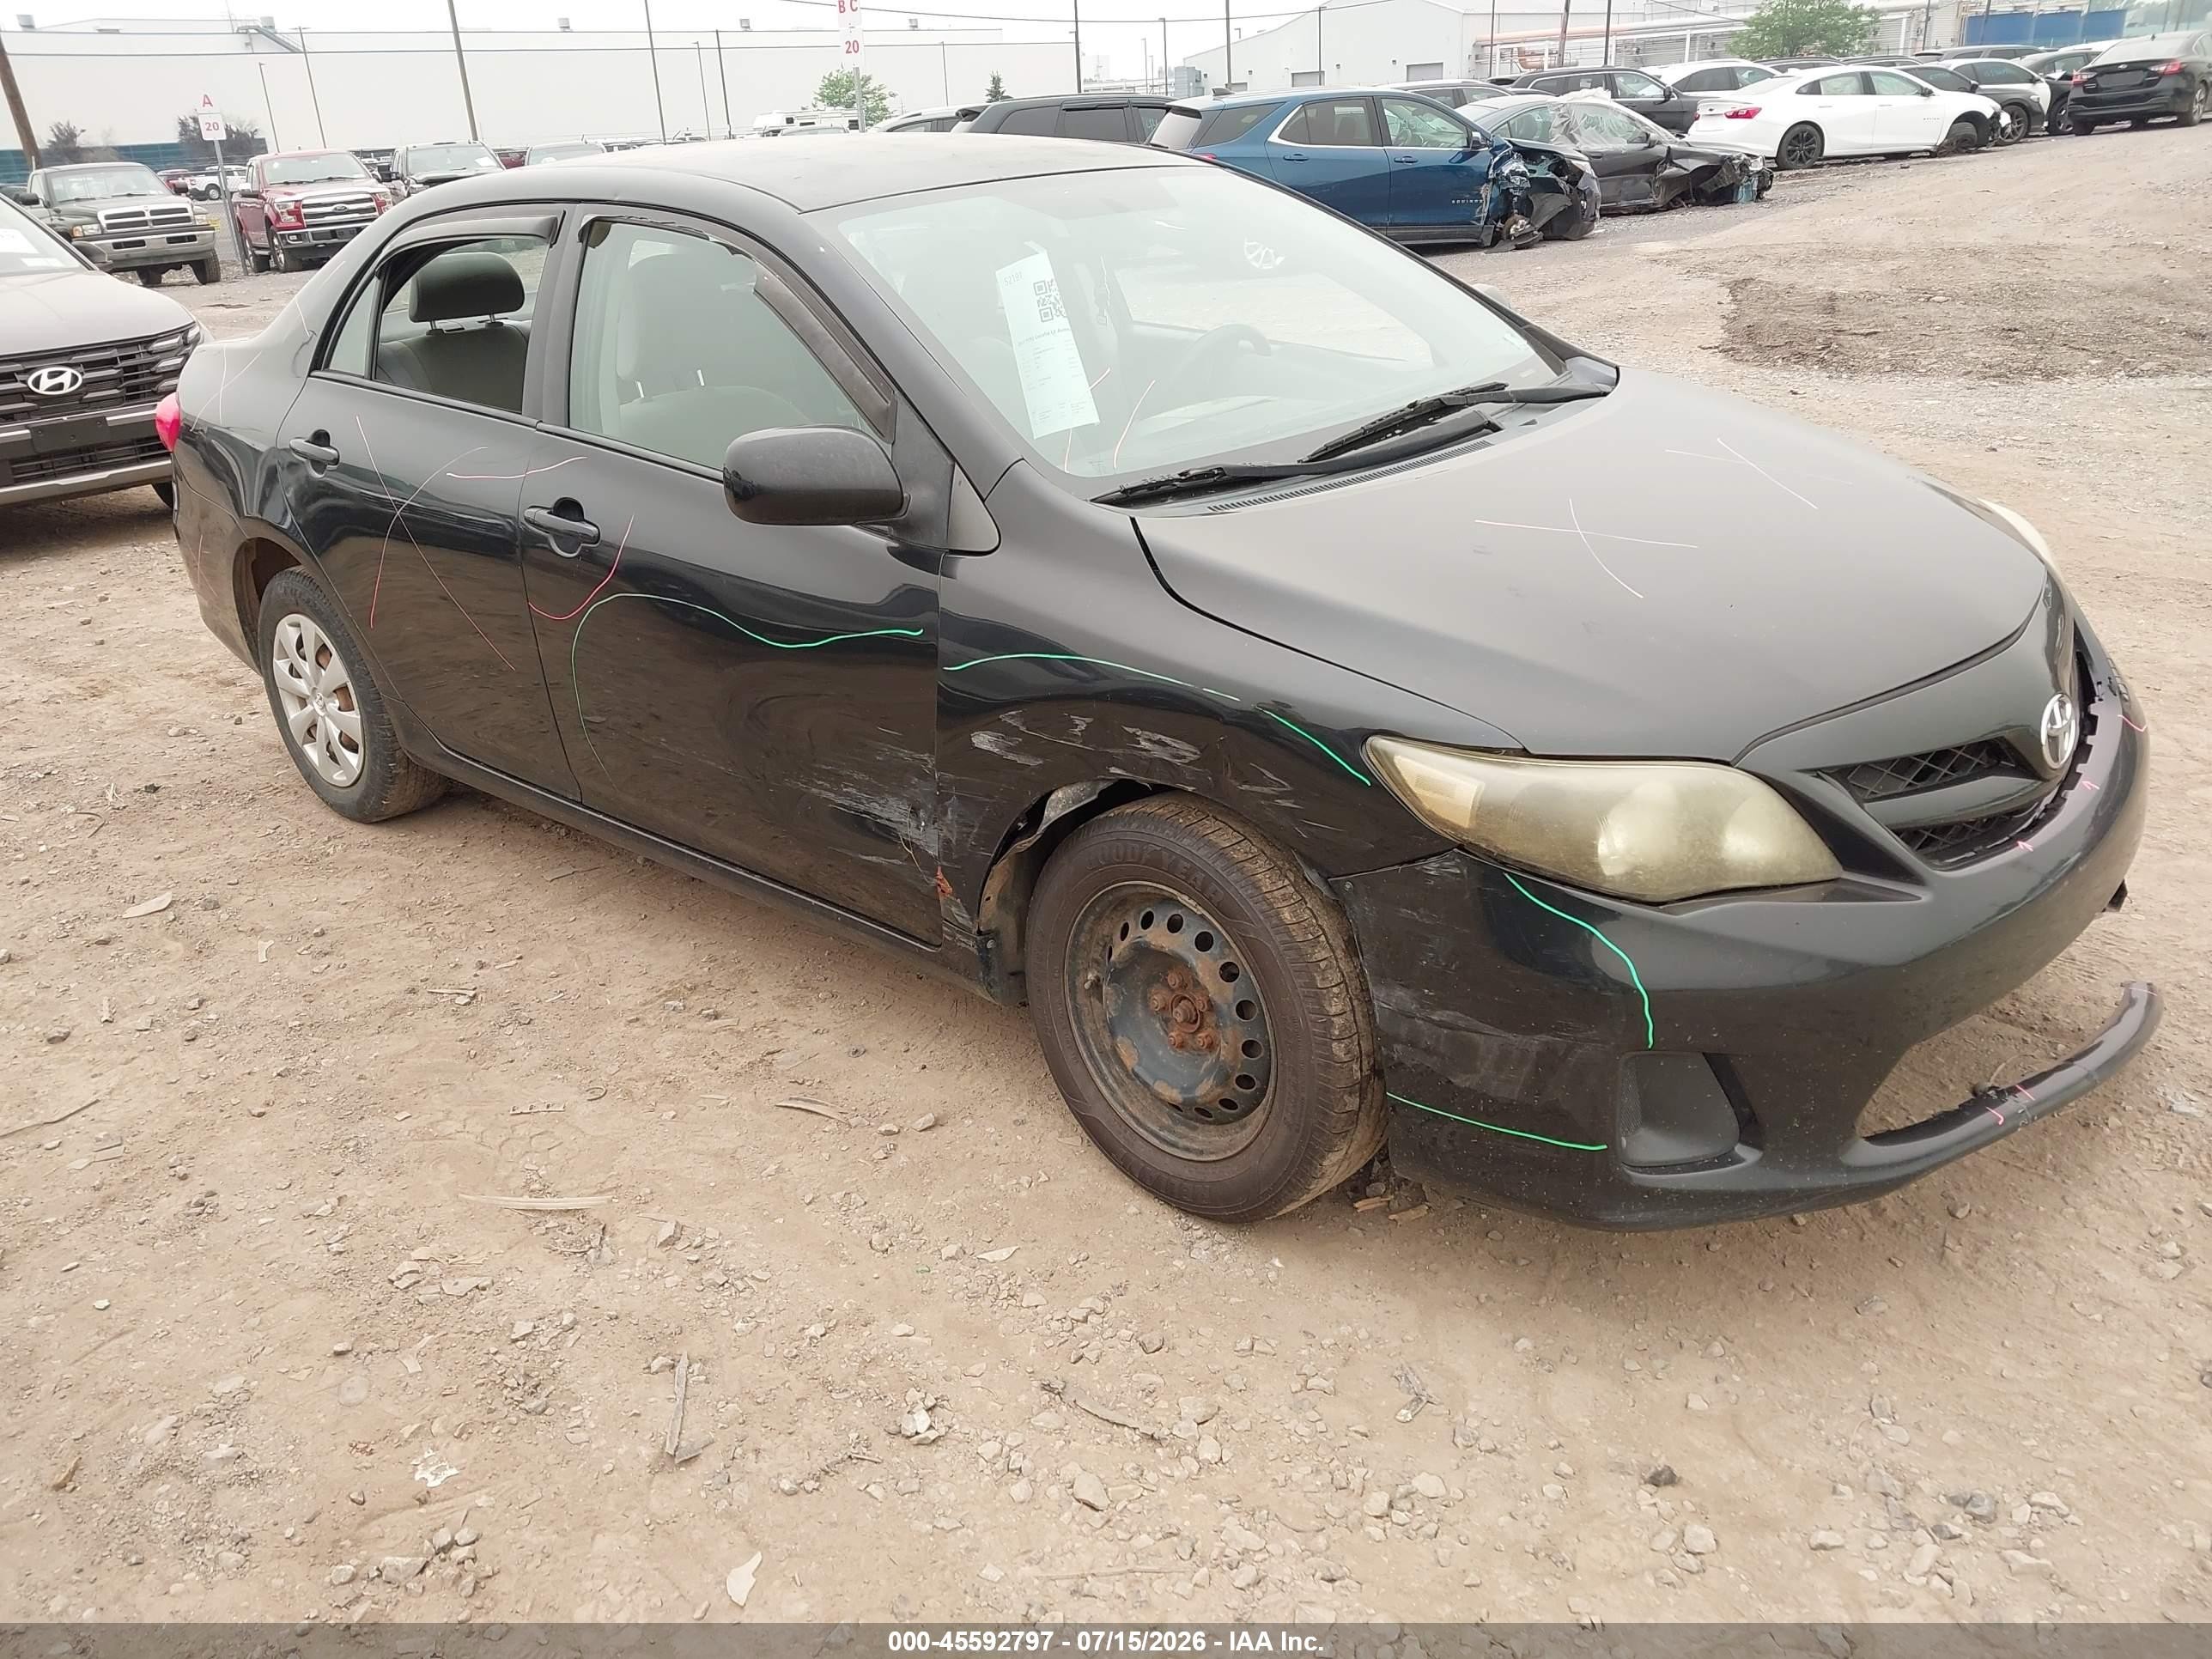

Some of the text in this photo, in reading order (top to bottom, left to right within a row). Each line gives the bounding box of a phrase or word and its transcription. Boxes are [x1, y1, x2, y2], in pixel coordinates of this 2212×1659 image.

[838, 0, 858, 13] B C
[845, 40, 860, 54] 20
[203, 94, 213, 107] A
[205, 122, 219, 131] 20
